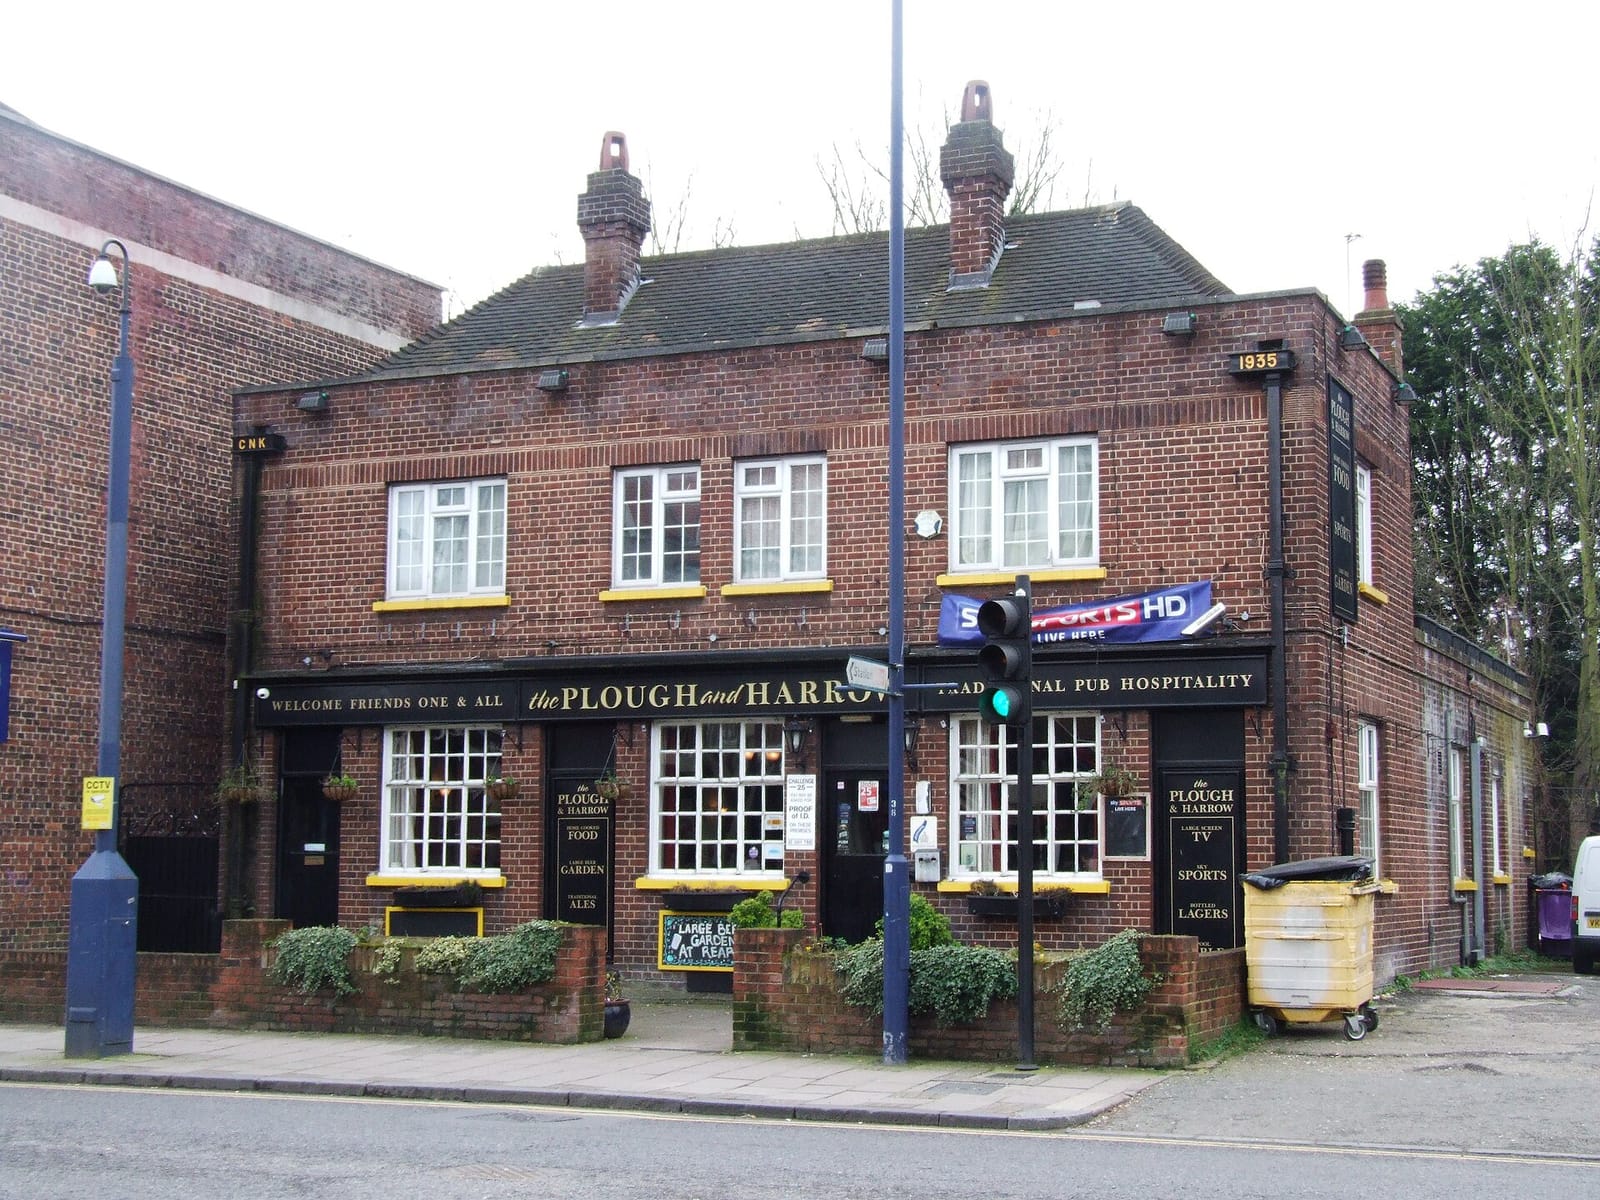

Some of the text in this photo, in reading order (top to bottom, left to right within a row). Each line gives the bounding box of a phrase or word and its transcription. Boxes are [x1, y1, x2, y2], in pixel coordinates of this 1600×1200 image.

[1240, 353, 1277, 369] 1935
[239, 437, 266, 450] CNK
[1333, 465, 1350, 490] FOOD
[1143, 595, 1186, 619] HD
[1037, 630, 1105, 643] LIVE HERE
[1075, 679, 1109, 692] PUB
[1121, 674, 1253, 691] HOSPITALITY
[529, 680, 889, 710] the PLOUGH and HARRO
[272, 695, 503, 712] WELCOME FRIENDS ONE & ALL
[86, 781, 110, 789] CCTV
[577, 784, 590, 792] the
[1193, 779, 1208, 788] the
[558, 793, 609, 805] PLOUGH
[1169, 789, 1234, 802] PLOUGH
[557, 806, 609, 815] & HARROW
[1169, 803, 1234, 813] & HARROW
[568, 830, 598, 840] FOOD
[1192, 831, 1212, 842] TV
[560, 865, 605, 875] GARDEN
[1178, 870, 1228, 881] SPORTS
[569, 899, 596, 909] ALES
[1178, 908, 1229, 919] LAGERS
[678, 923, 713, 934] LARGE
[690, 934, 735, 947] GARDEN
[679, 944, 693, 959] AT
